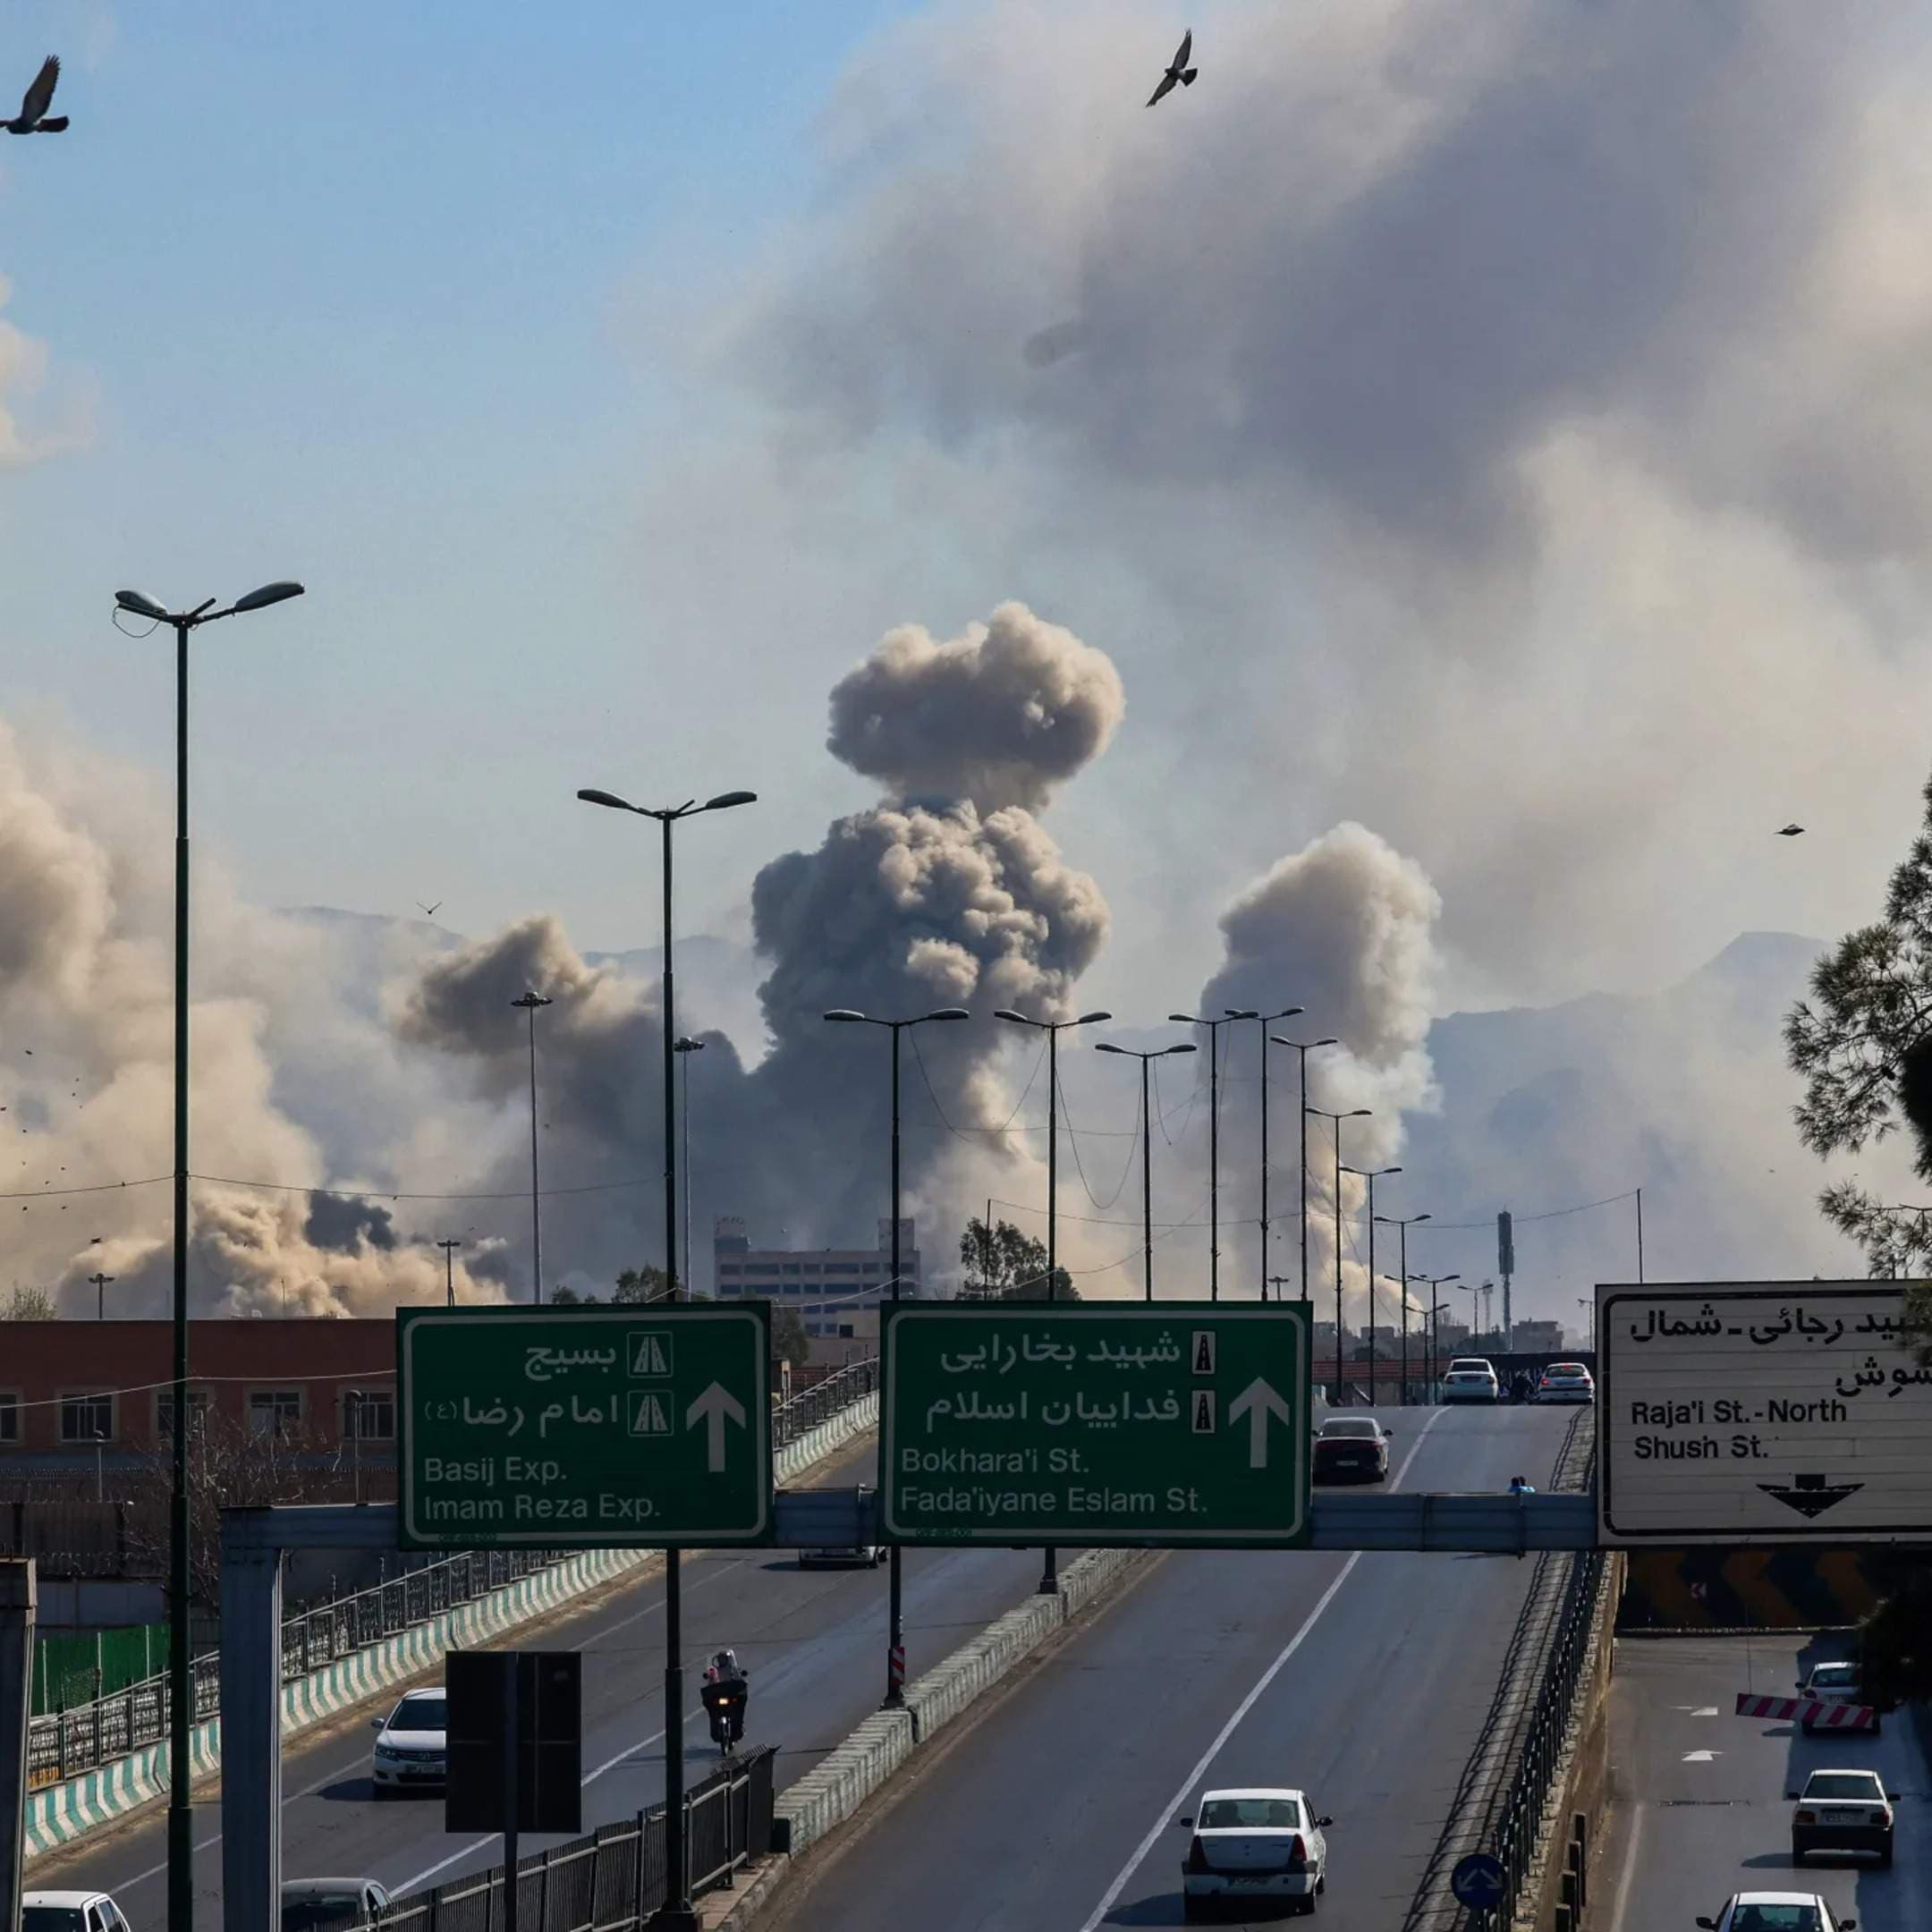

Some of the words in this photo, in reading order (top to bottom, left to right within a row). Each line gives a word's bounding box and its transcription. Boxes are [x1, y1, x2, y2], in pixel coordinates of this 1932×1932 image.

[525, 1345, 616, 1381] بسیج
[941, 1333, 1077, 1374] بخارایی
[1087, 1331, 1181, 1369] شهید
[540, 1394, 617, 1437] امام
[927, 1391, 1028, 1433] اسلام
[1042, 1389, 1181, 1428] فداییان
[1631, 1401, 1704, 1428] Raja'i
[902, 1447, 1038, 1473] Bokhara'i
[1048, 1448, 1089, 1473] St.
[1634, 1435, 1718, 1459] Shush
[1731, 1435, 1768, 1458] St.
[425, 1457, 495, 1487] Basij
[506, 1457, 567, 1484] Exp.
[425, 1496, 504, 1520] Imam
[515, 1495, 587, 1519] Reza
[599, 1493, 661, 1521] Exp.
[901, 1487, 1056, 1516] Fada'iyane
[1068, 1487, 1155, 1513] Eslam
[1166, 1487, 1208, 1513] St.
